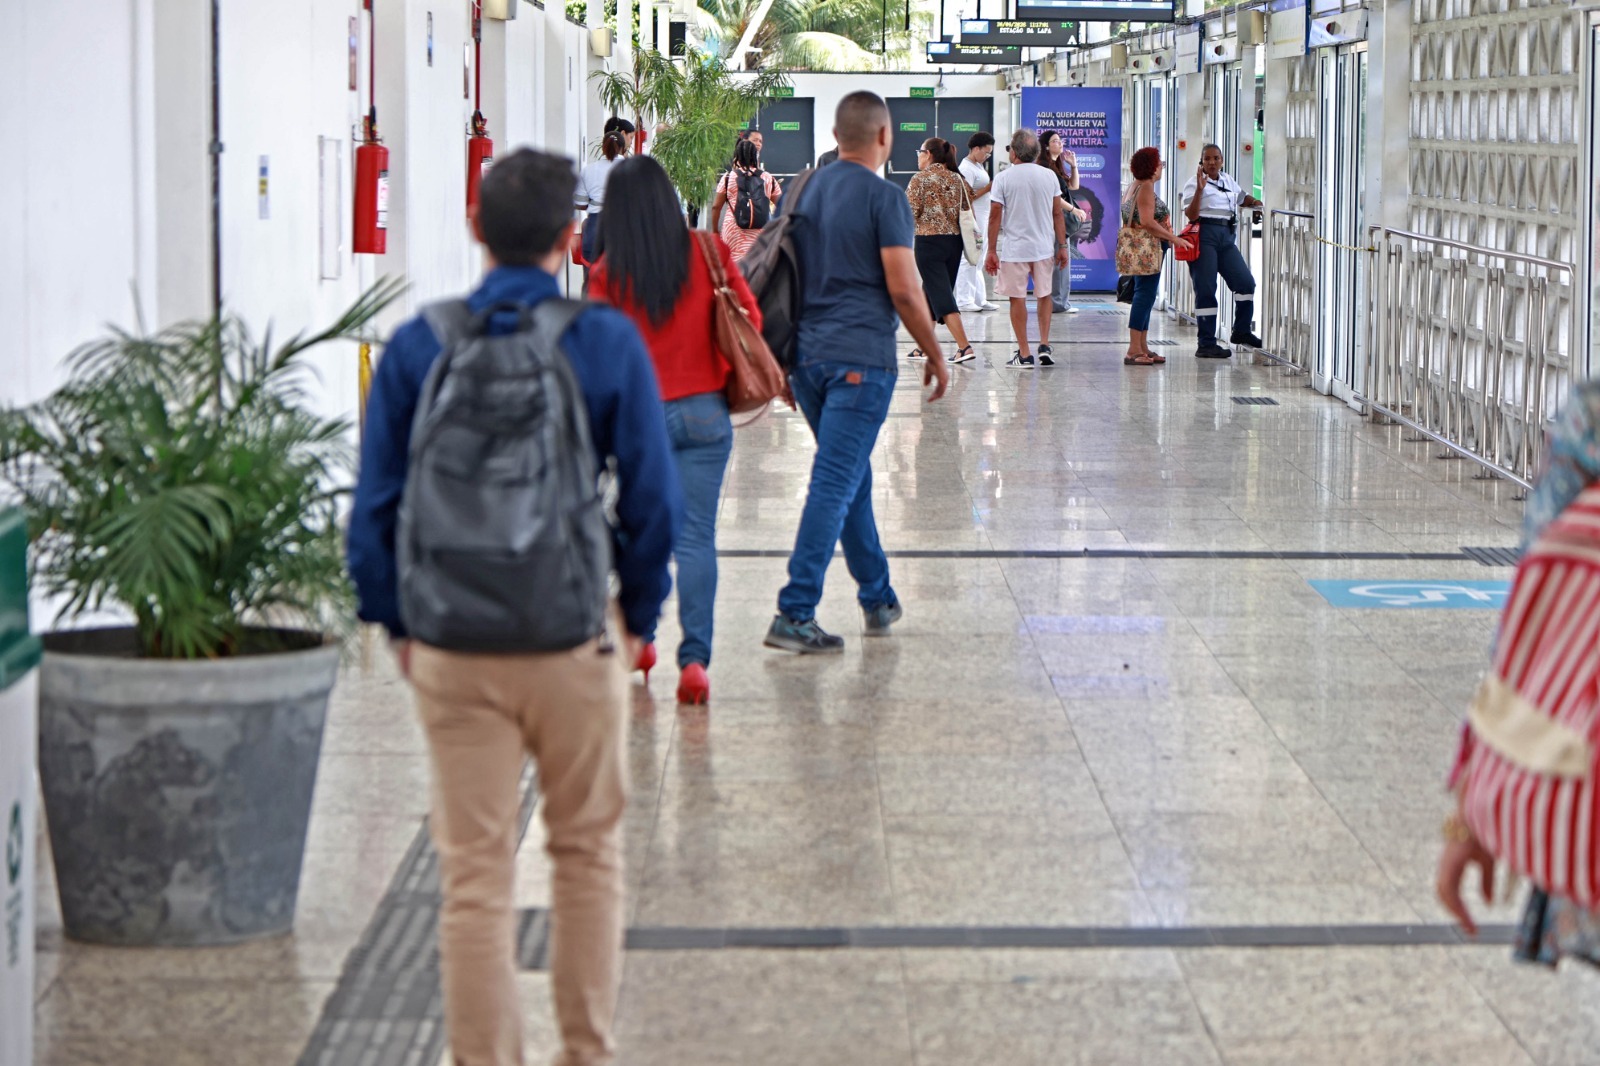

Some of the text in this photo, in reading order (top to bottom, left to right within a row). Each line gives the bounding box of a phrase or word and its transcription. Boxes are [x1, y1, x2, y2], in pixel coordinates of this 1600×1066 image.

[1067, 35, 1078, 44] A
[911, 88, 933, 96] SAÍDA
[1036, 111, 1055, 119] AQUI,
[1069, 138, 1105, 146] INTEIRA.
